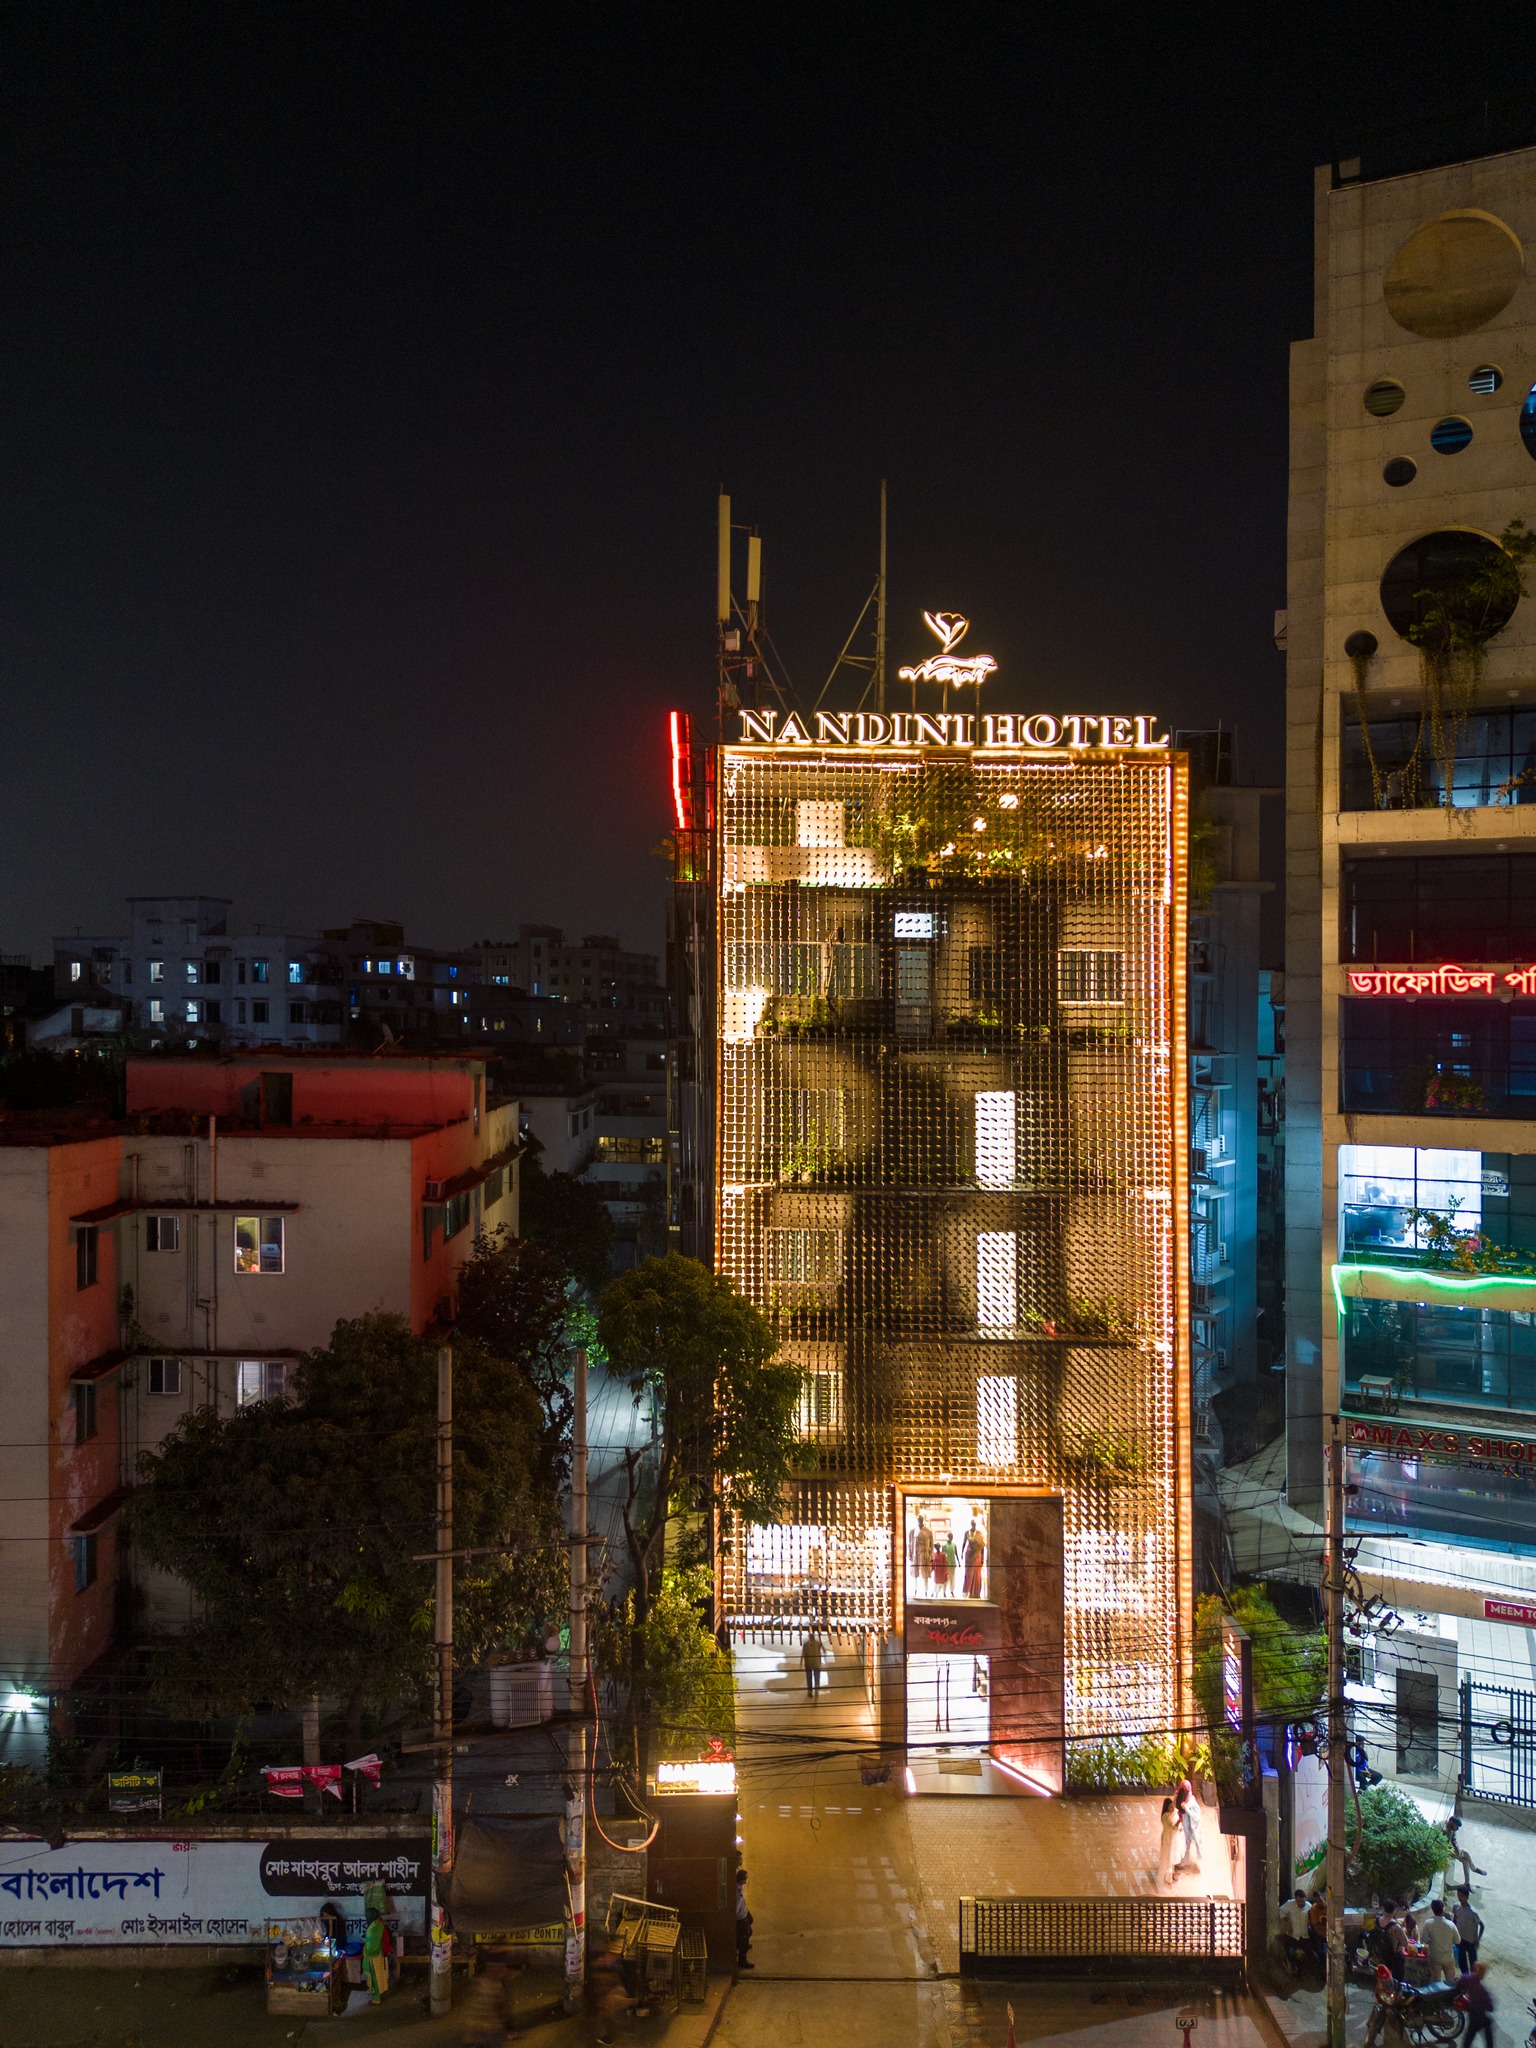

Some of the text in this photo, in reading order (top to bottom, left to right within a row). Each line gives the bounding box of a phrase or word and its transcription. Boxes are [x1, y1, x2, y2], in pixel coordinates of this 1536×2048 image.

[739, 709, 1170, 749] NANDINI HOTEL
[1349, 964, 1496, 995] ড্যাফোডিল
[1372, 1424, 1460, 1453] MAX'S
[1490, 1603, 1524, 1618] MEEM
[265, 1856, 421, 1881] মোঃ মাহাবুব আলম শাহীন
[0, 1866, 165, 1900] বাংলাদেশ
[3, 1919, 42, 1938] হোসেন
[45, 1919, 75, 1941] বাবুল
[121, 1917, 146, 1935] মোঃ
[147, 1912, 203, 1938] ইসমাইল
[206, 1917, 249, 1938] হোসেন
[534, 1928, 564, 1940] CONTR
